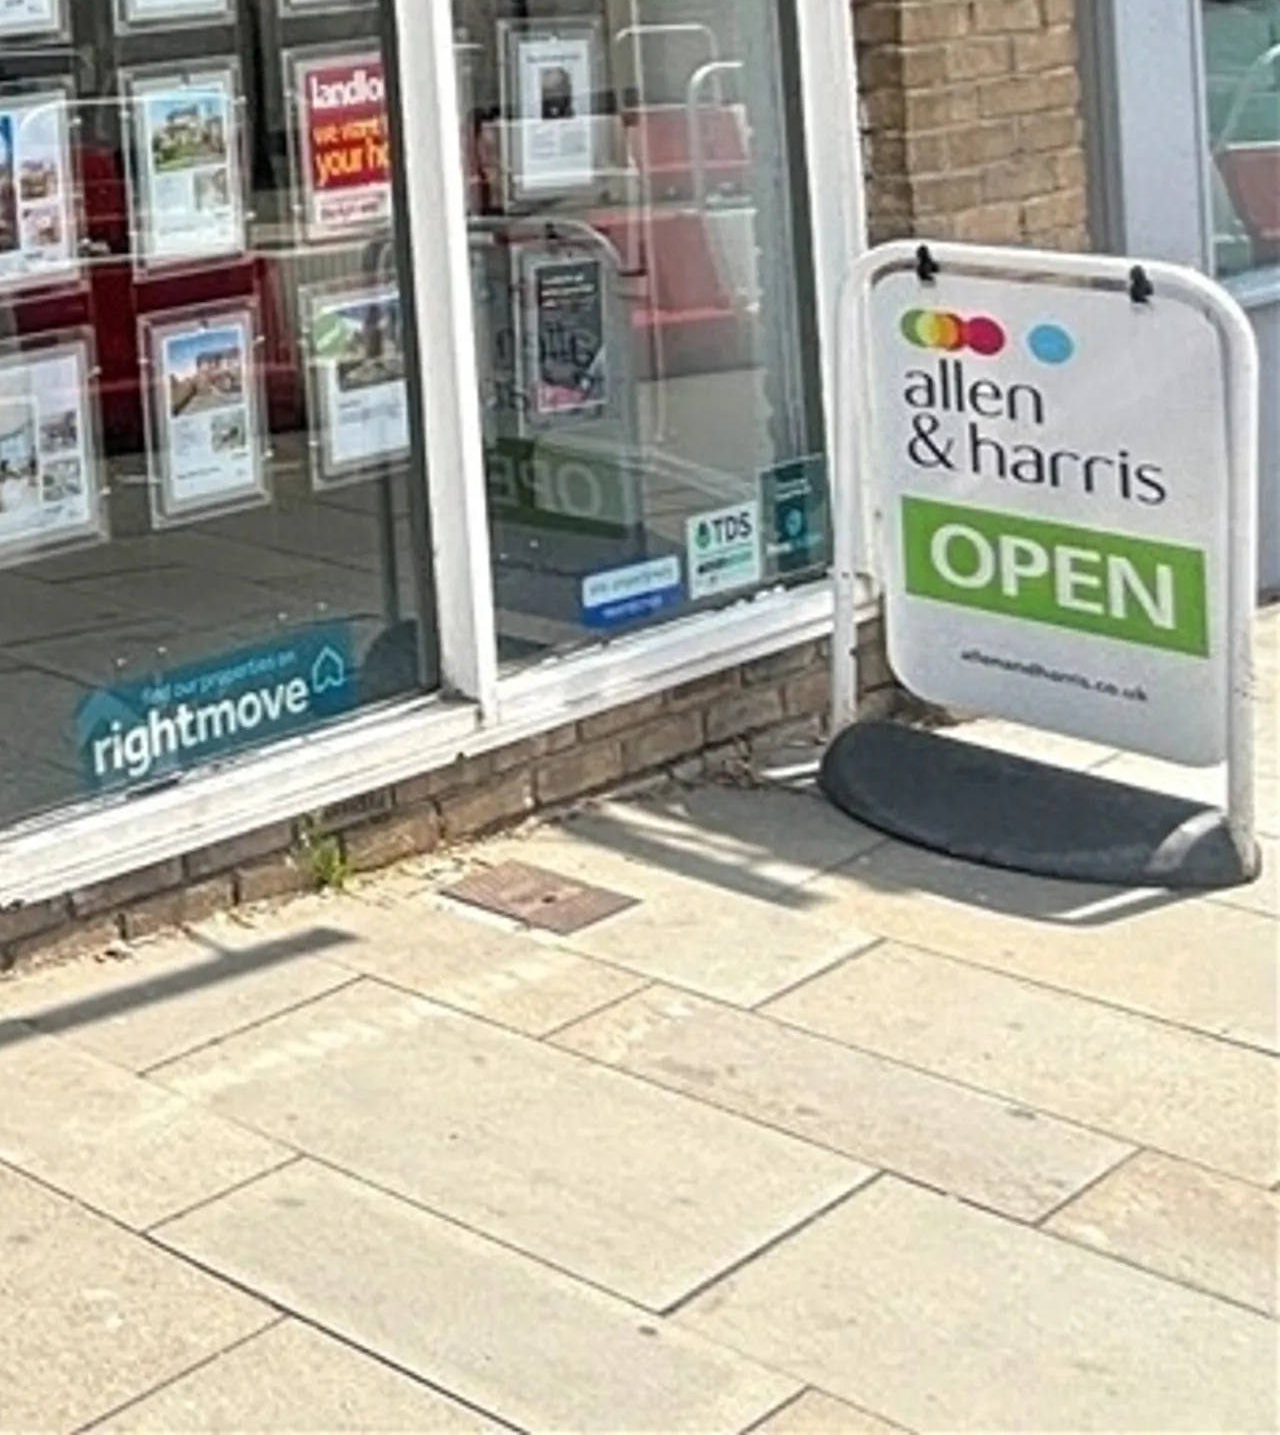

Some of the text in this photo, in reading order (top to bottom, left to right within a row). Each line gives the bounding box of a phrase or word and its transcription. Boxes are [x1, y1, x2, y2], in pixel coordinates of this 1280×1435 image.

[315, 147, 363, 188] your
[904, 358, 1044, 425] allen
[907, 413, 1167, 506] & harris
[710, 512, 754, 544] TDS
[930, 523, 1177, 631] OPEN
[92, 675, 311, 778] rightmove
